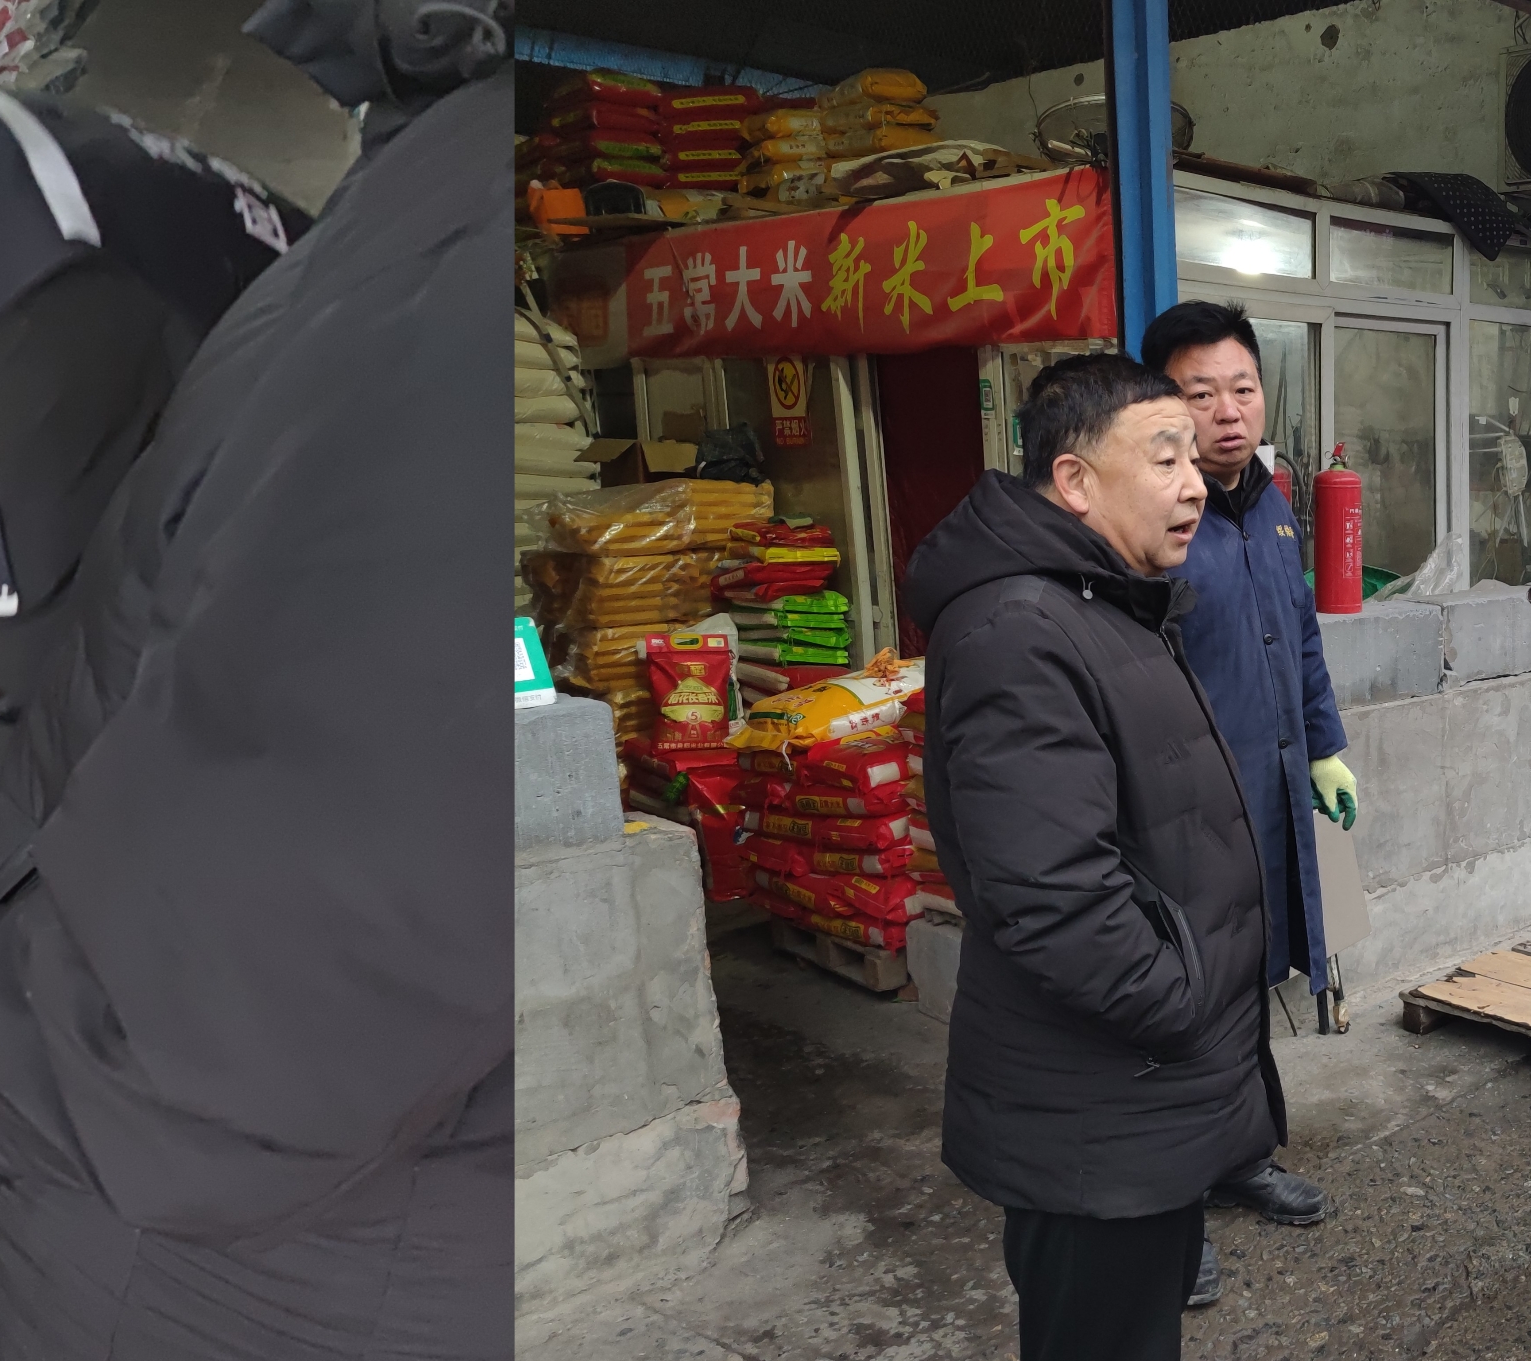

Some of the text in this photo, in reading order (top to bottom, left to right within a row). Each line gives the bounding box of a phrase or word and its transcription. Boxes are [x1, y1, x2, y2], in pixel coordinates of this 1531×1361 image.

[641, 197, 1086, 339] 五常大米 新米上市
[774, 420, 808, 437] 严禁烟火
[689, 710, 698, 720] 5
